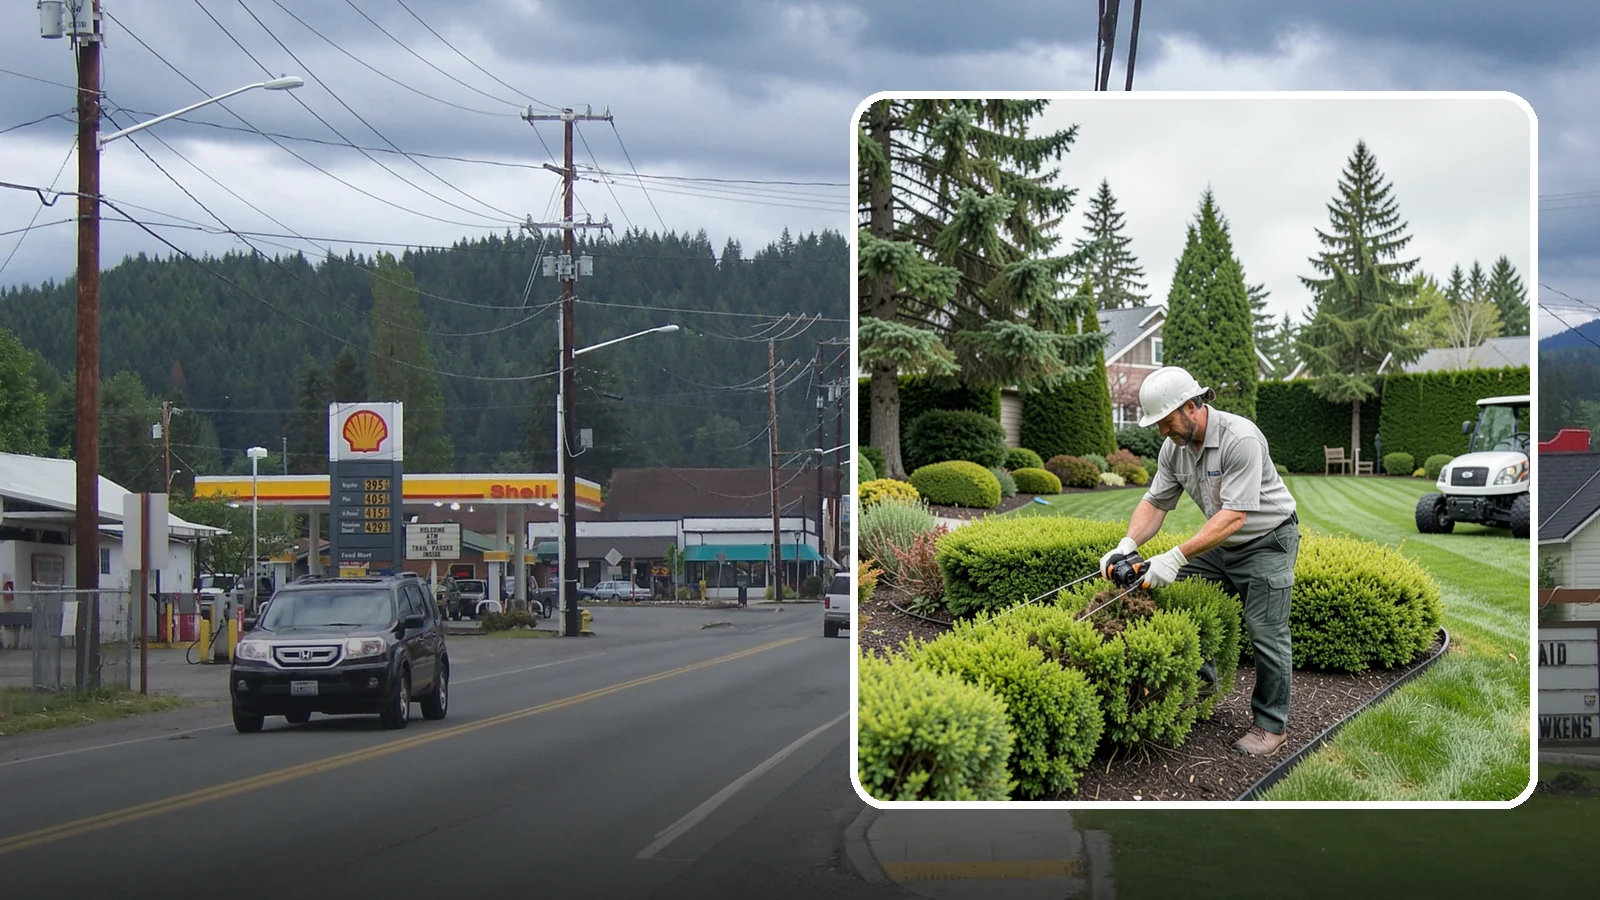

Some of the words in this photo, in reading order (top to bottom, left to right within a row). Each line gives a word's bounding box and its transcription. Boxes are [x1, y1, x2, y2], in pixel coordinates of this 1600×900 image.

[366, 480, 383, 490] 395
[490, 484, 547, 499] Shell
[366, 494, 383, 504] 405
[366, 508, 383, 518] 415
[366, 522, 383, 533] 429
